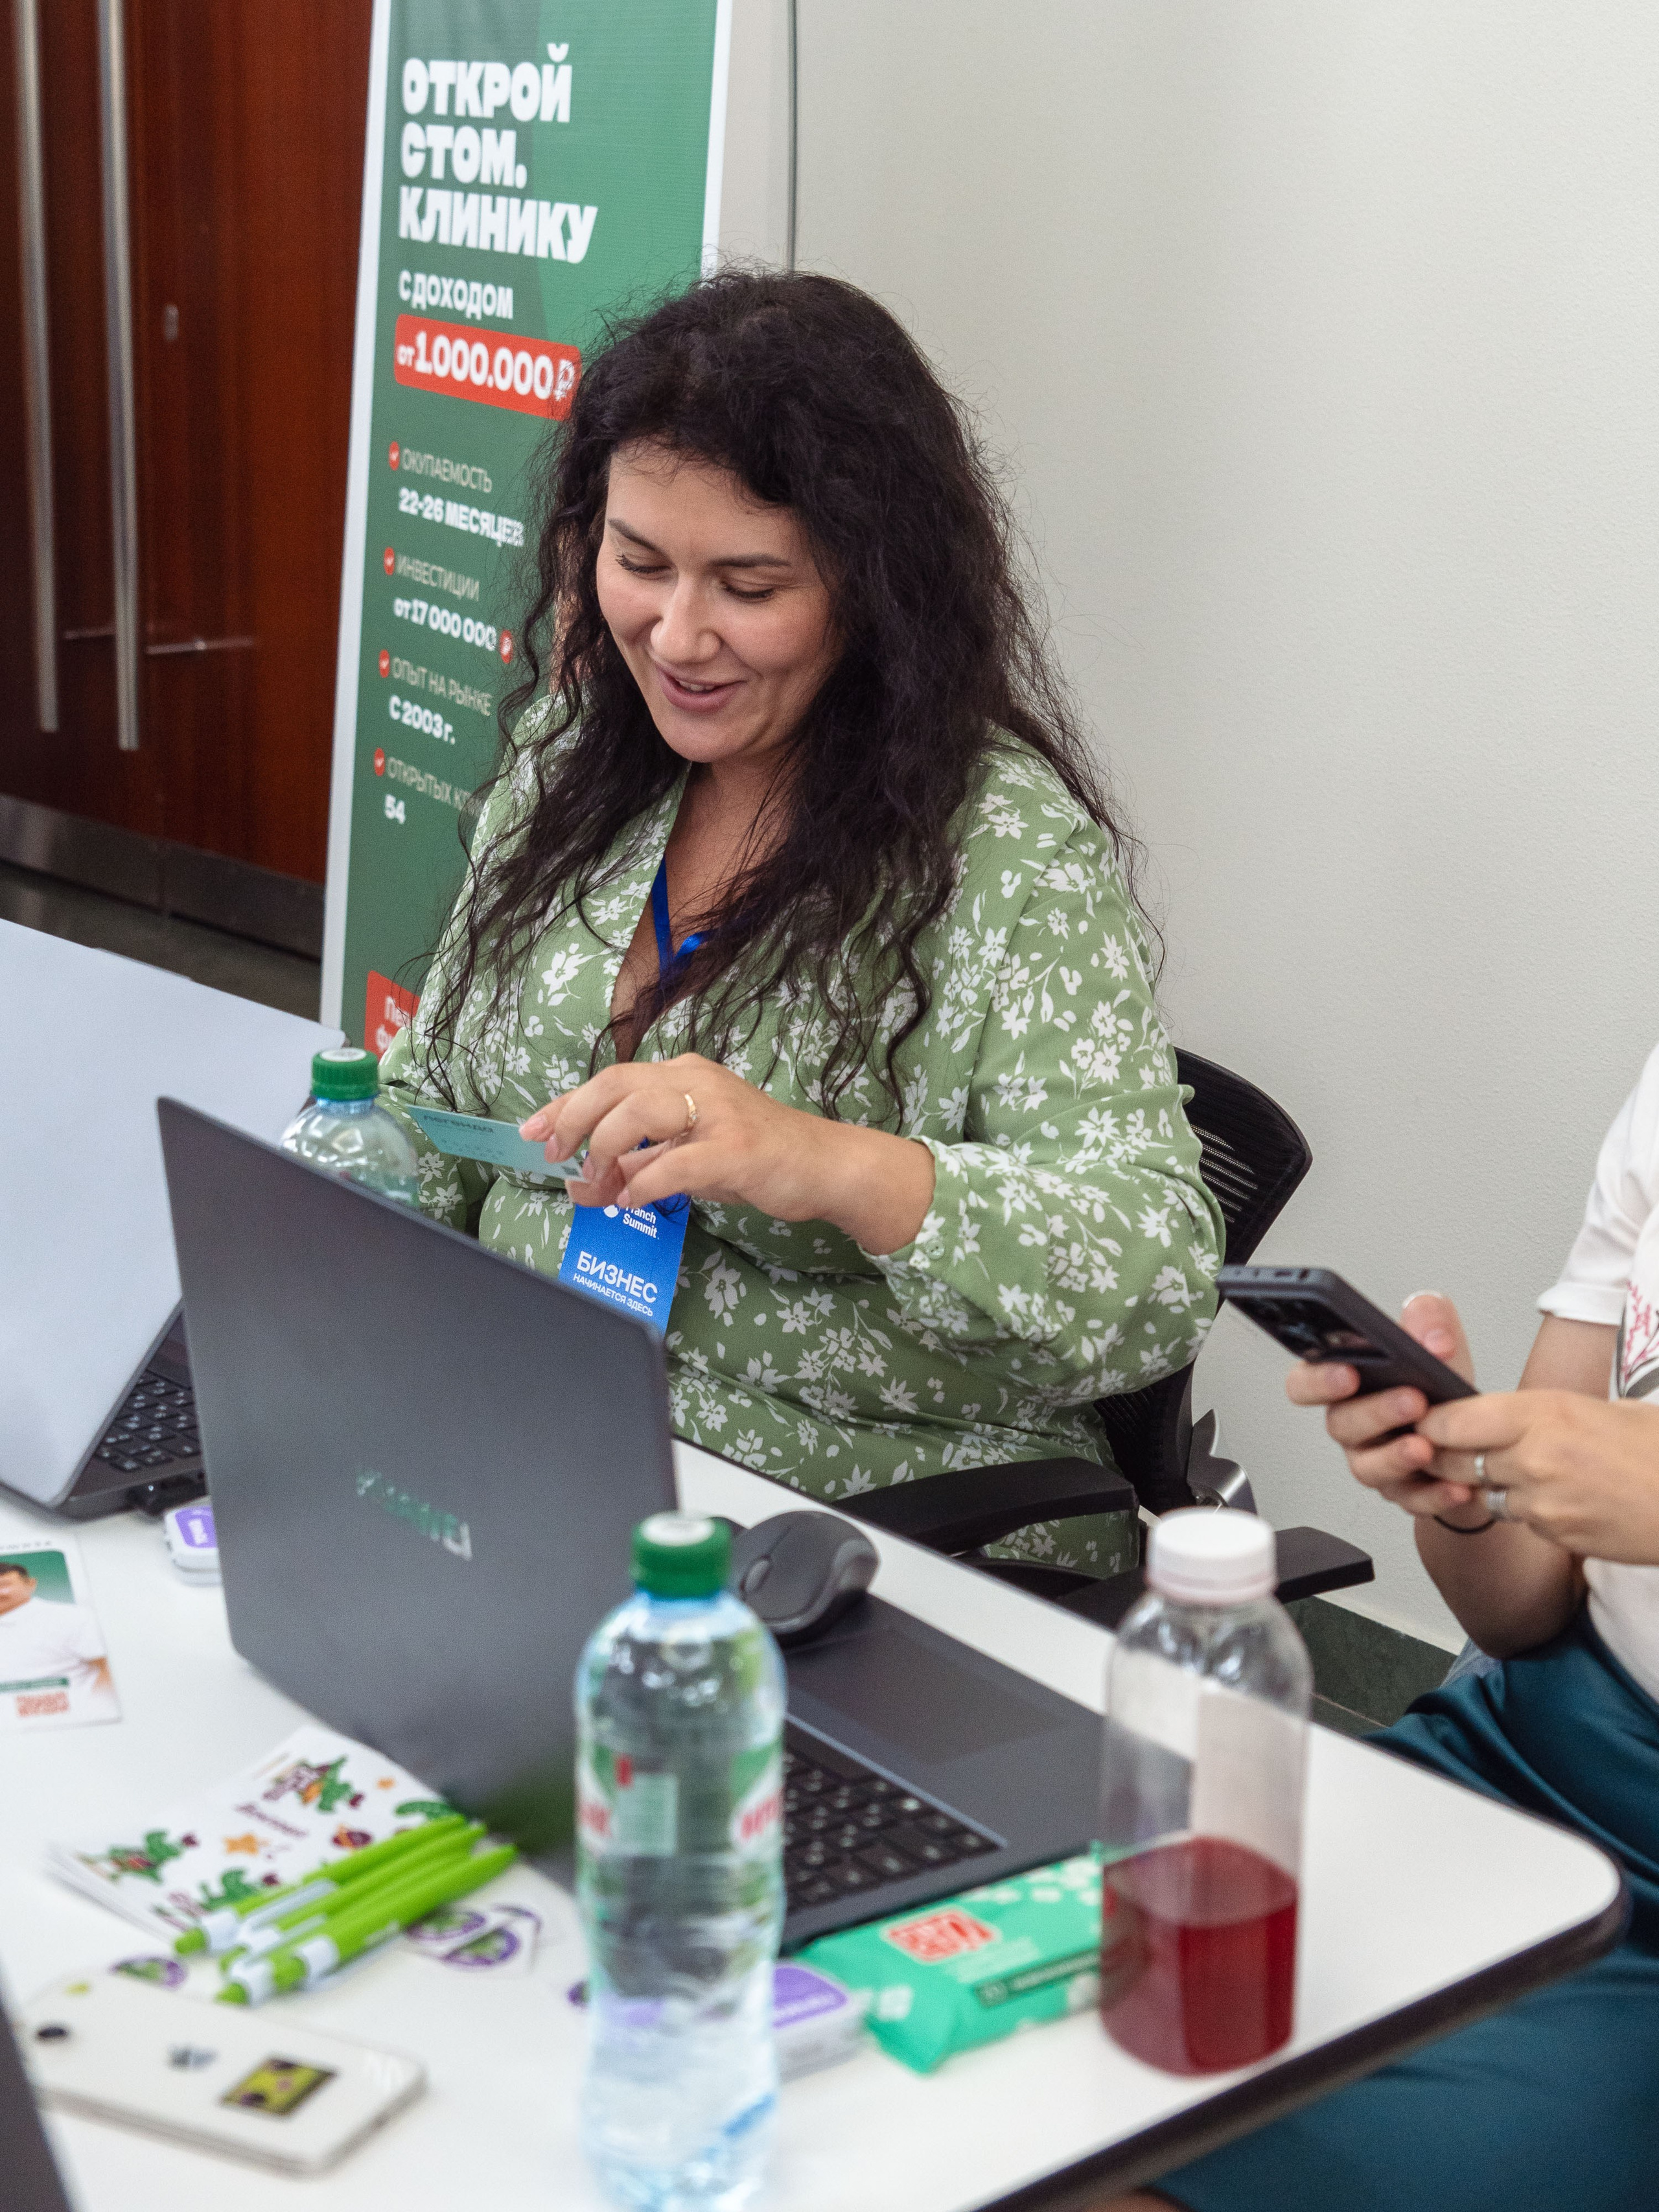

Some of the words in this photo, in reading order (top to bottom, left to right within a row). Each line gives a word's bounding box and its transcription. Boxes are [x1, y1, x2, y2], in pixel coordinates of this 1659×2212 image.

[402, 43, 573, 122] ОТКРОЙ
[401, 122, 528, 189] СТОМ.
[399, 185, 598, 263] КЛИНИКУ
[402, 448, 493, 493] ОКУПАЕМОСТЬ
[399, 487, 444, 522] 22-26
[445, 500, 524, 548] МЕСЯЦЕВ
[397, 554, 480, 601] ИНВЕСТИЦИИ
[391, 657, 428, 688] ОПЫТ
[428, 672, 447, 698] НА
[448, 679, 493, 717] РЫНКЕ
[388, 757, 452, 805] ОТКРЫТЫХ
[384, 794, 406, 824] 54
[573, 1273, 627, 1305] НАЧИНАЕТСЯ
[627, 1298, 654, 1317] ЗДЕСЬ
[576, 1251, 658, 1303] БИЗНЕС
